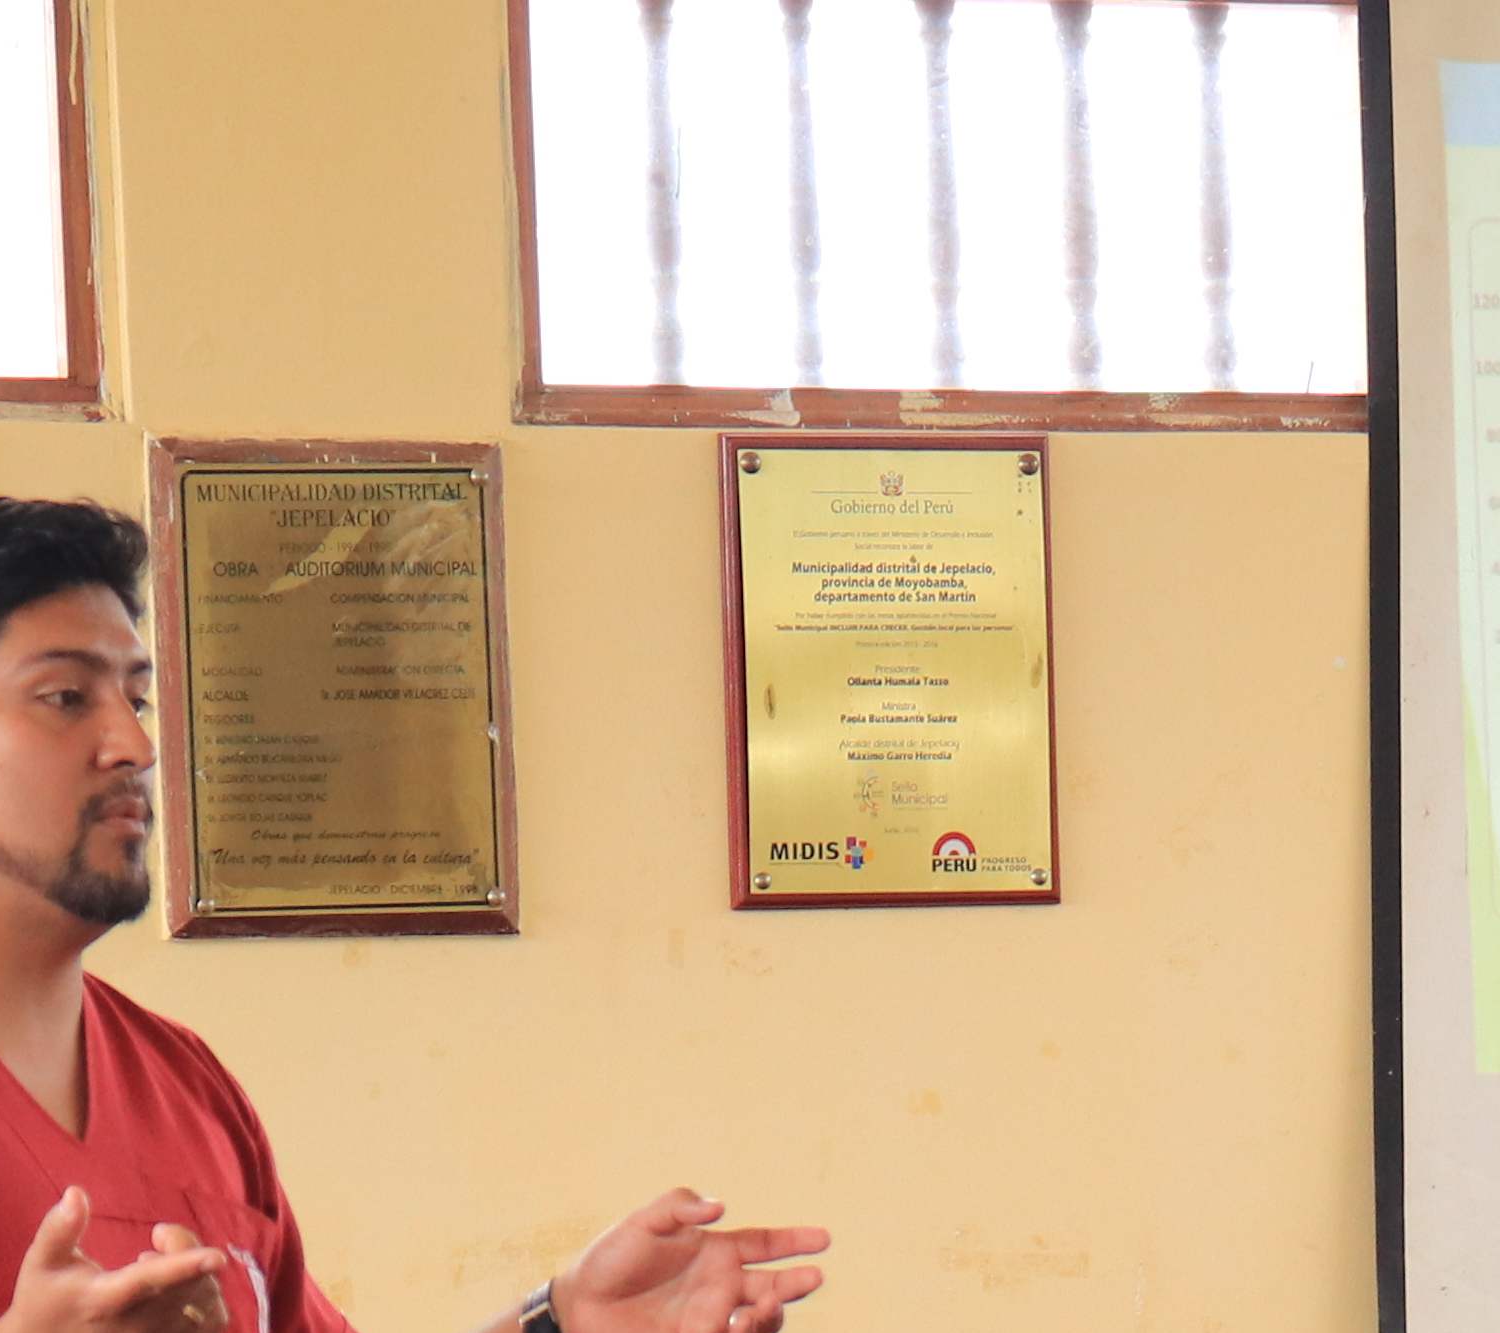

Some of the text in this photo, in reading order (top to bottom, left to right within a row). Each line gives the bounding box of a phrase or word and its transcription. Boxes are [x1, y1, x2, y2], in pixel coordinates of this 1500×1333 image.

[196, 482, 468, 502] MUNICIPALIDAD DISTRITAL
[831, 499, 954, 515] Gobierno del Perú
[270, 509, 396, 528] "JEPELACIO"
[213, 562, 258, 577] OBRA
[285, 561, 478, 576] AUDITORIUM MUNICIPAL
[792, 561, 996, 576] Municipalidad distrital de Jepelacio,
[821, 577, 967, 591] provincia de Moyobamba,
[814, 591, 896, 605] departamento
[898, 591, 912, 603] de
[915, 592, 936, 603] San
[200, 623, 241, 634] EJECUTA
[202, 667, 262, 677] MODALIDAD
[875, 664, 920, 673] Presidente
[848, 677, 949, 686] Ollanta Humala Tasso
[202, 690, 248, 701] ALCALDE
[881, 702, 916, 711] Ministra
[204, 714, 254, 725] REGIDORES
[840, 714, 958, 724] Paola Bustamante Suárez
[848, 751, 952, 760] Máximo Garro Heredia
[891, 781, 917, 792] Sello
[891, 794, 948, 805] Municipal
[770, 842, 840, 860] MIDIS
[252, 853, 270, 870] vez
[278, 849, 306, 864] más
[312, 850, 376, 866] pensando
[383, 854, 396, 864] en
[403, 849, 416, 864] la
[931, 858, 977, 872] PERU
